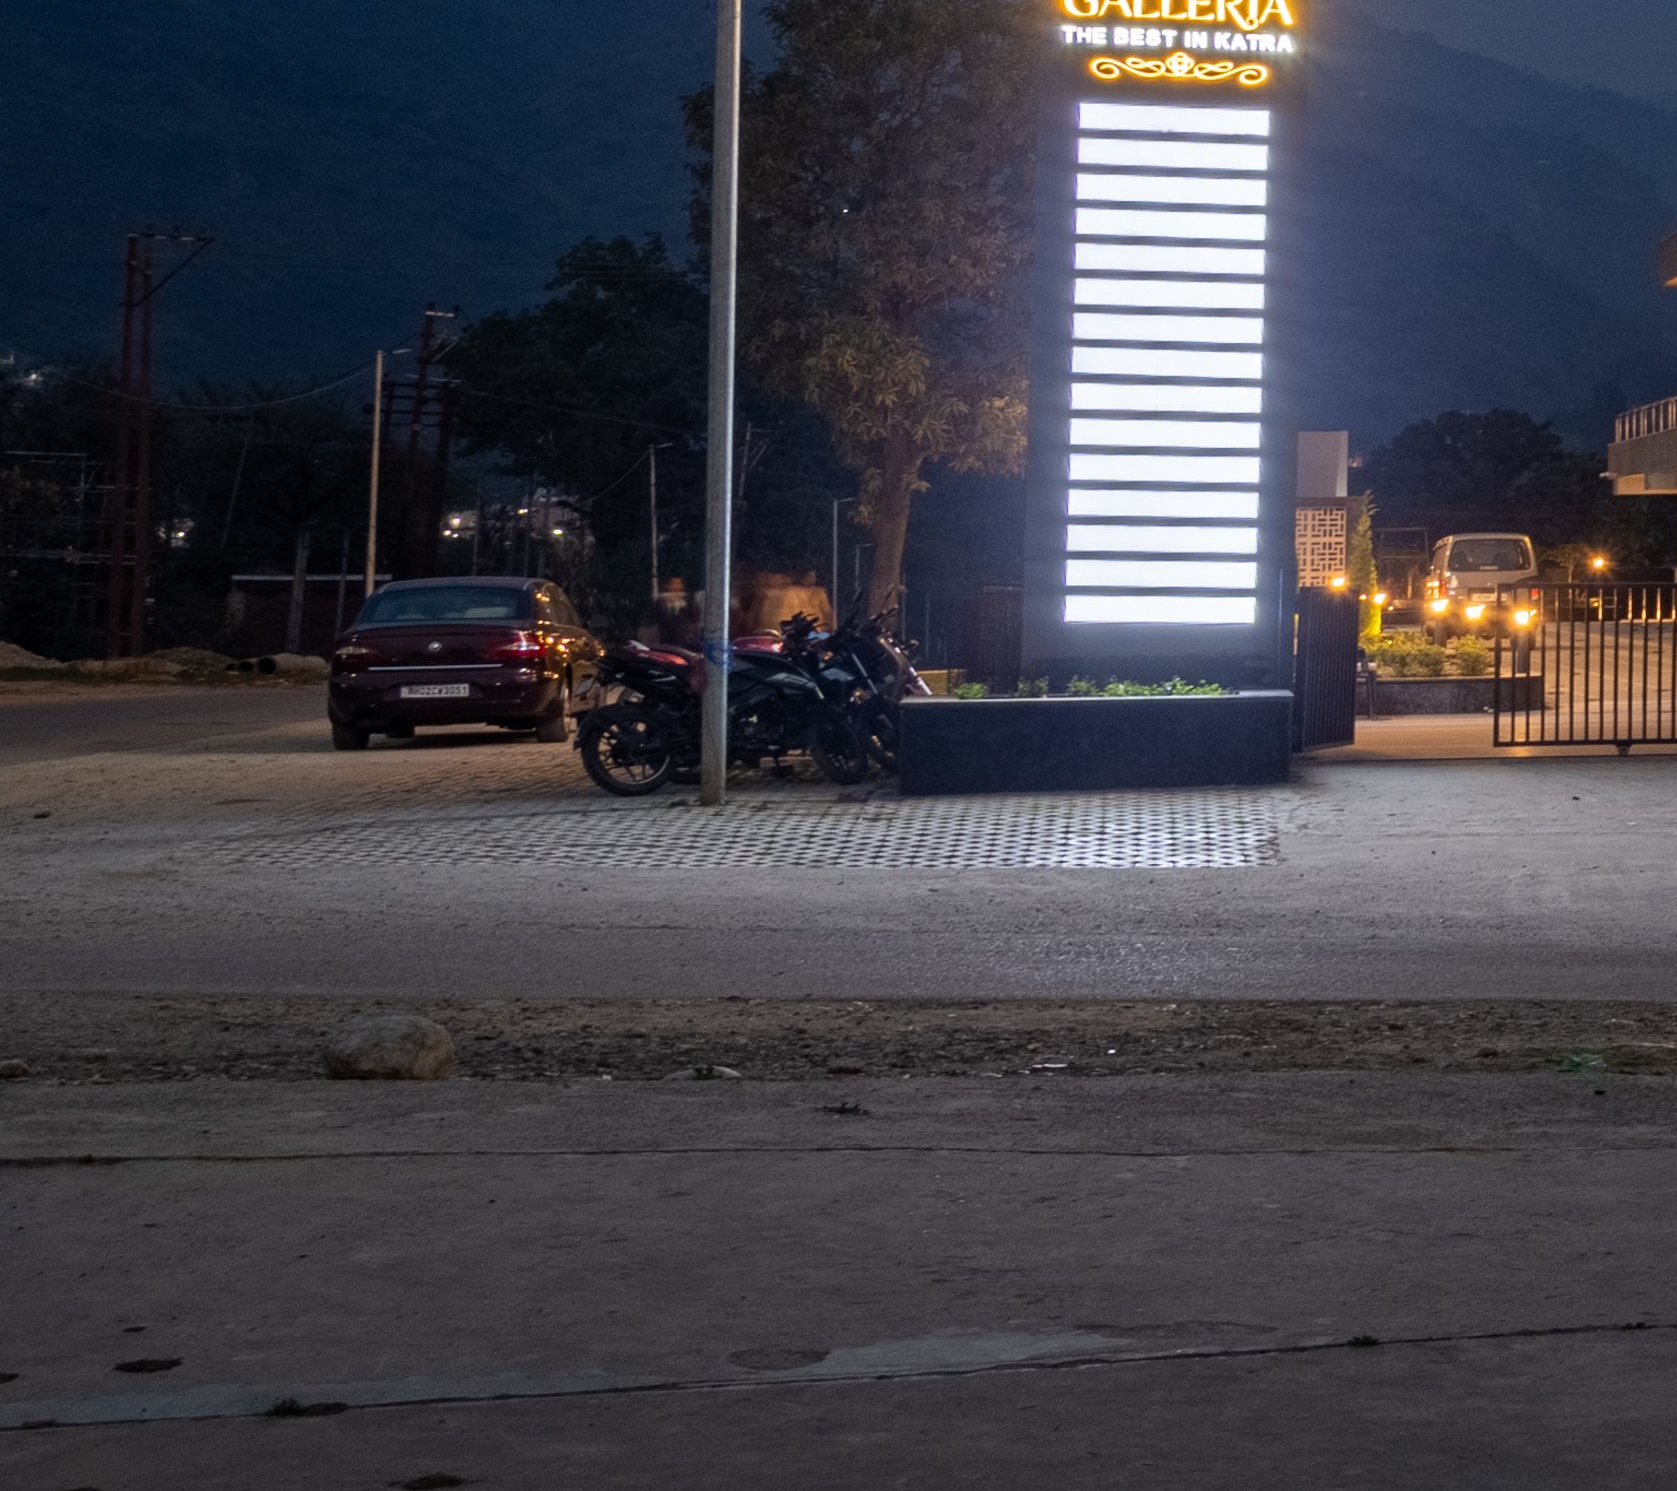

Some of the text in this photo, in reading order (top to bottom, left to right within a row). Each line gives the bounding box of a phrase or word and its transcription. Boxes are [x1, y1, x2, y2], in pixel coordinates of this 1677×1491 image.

[1060, 24, 1296, 54] THE BEST IN KATRA
